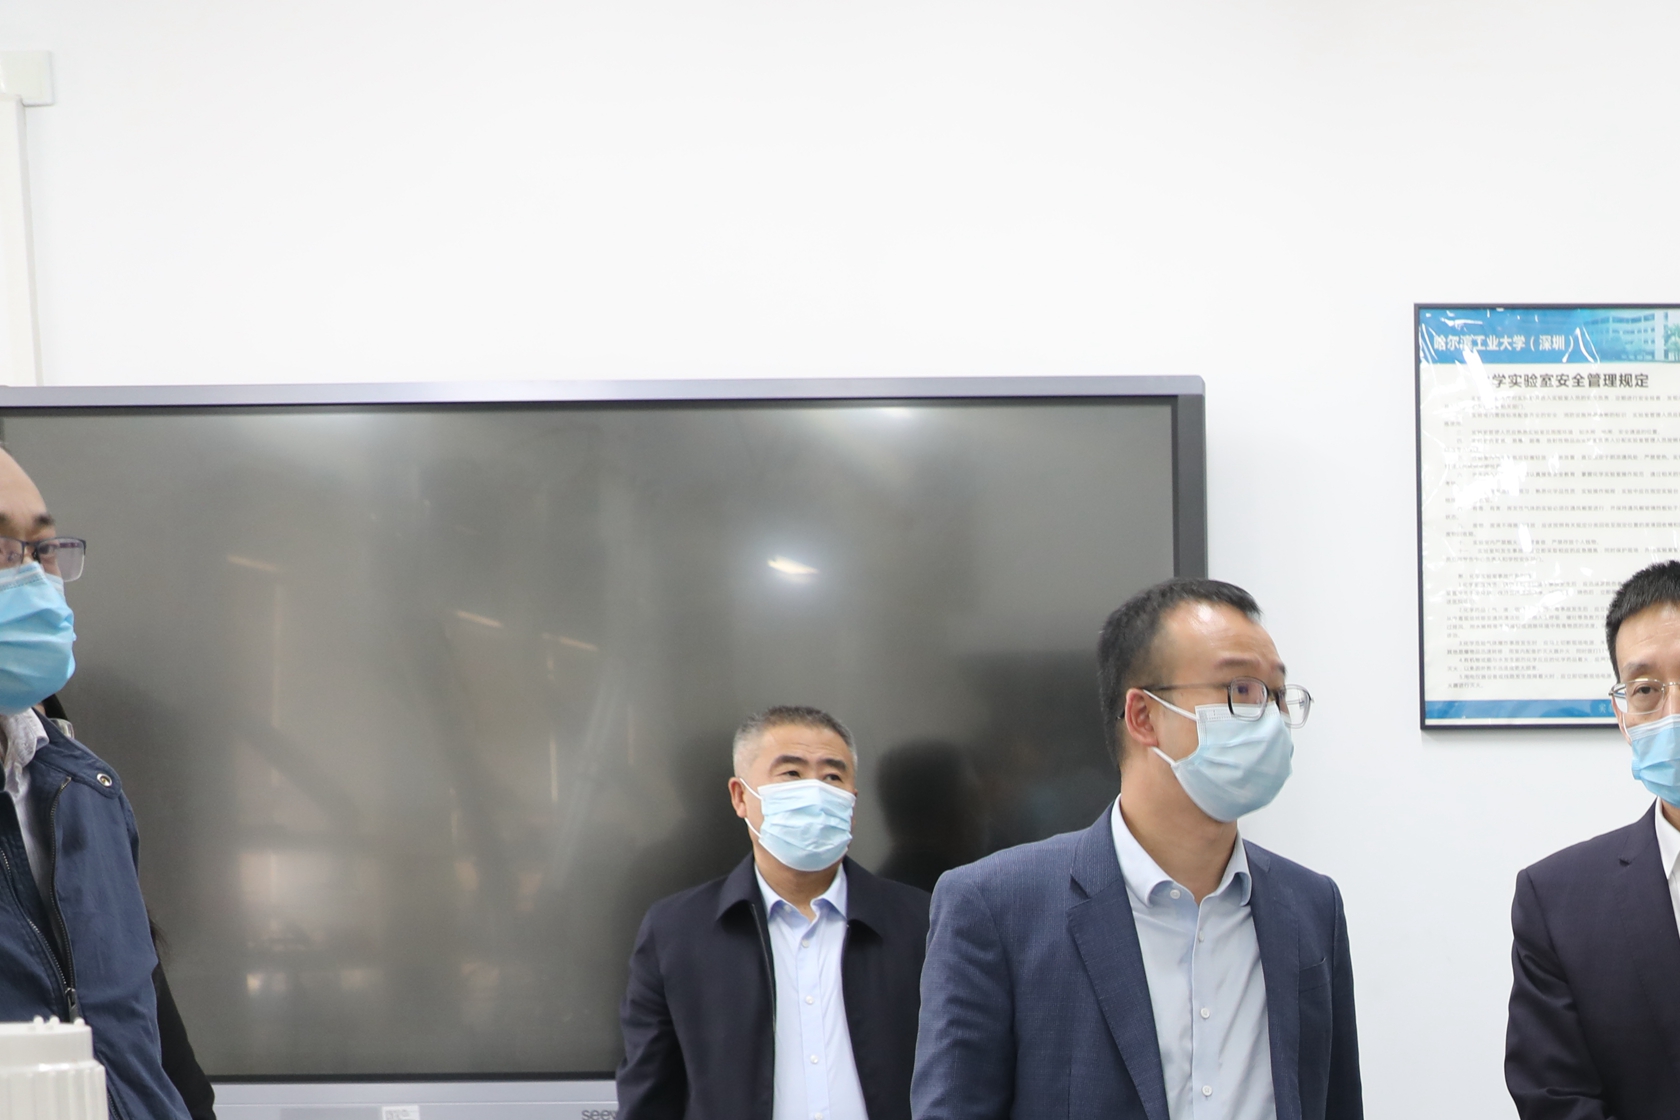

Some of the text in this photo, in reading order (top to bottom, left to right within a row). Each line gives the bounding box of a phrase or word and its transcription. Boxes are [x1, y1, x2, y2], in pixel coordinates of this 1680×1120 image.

[1488, 373, 1649, 388] 学实验室安全管理规定
